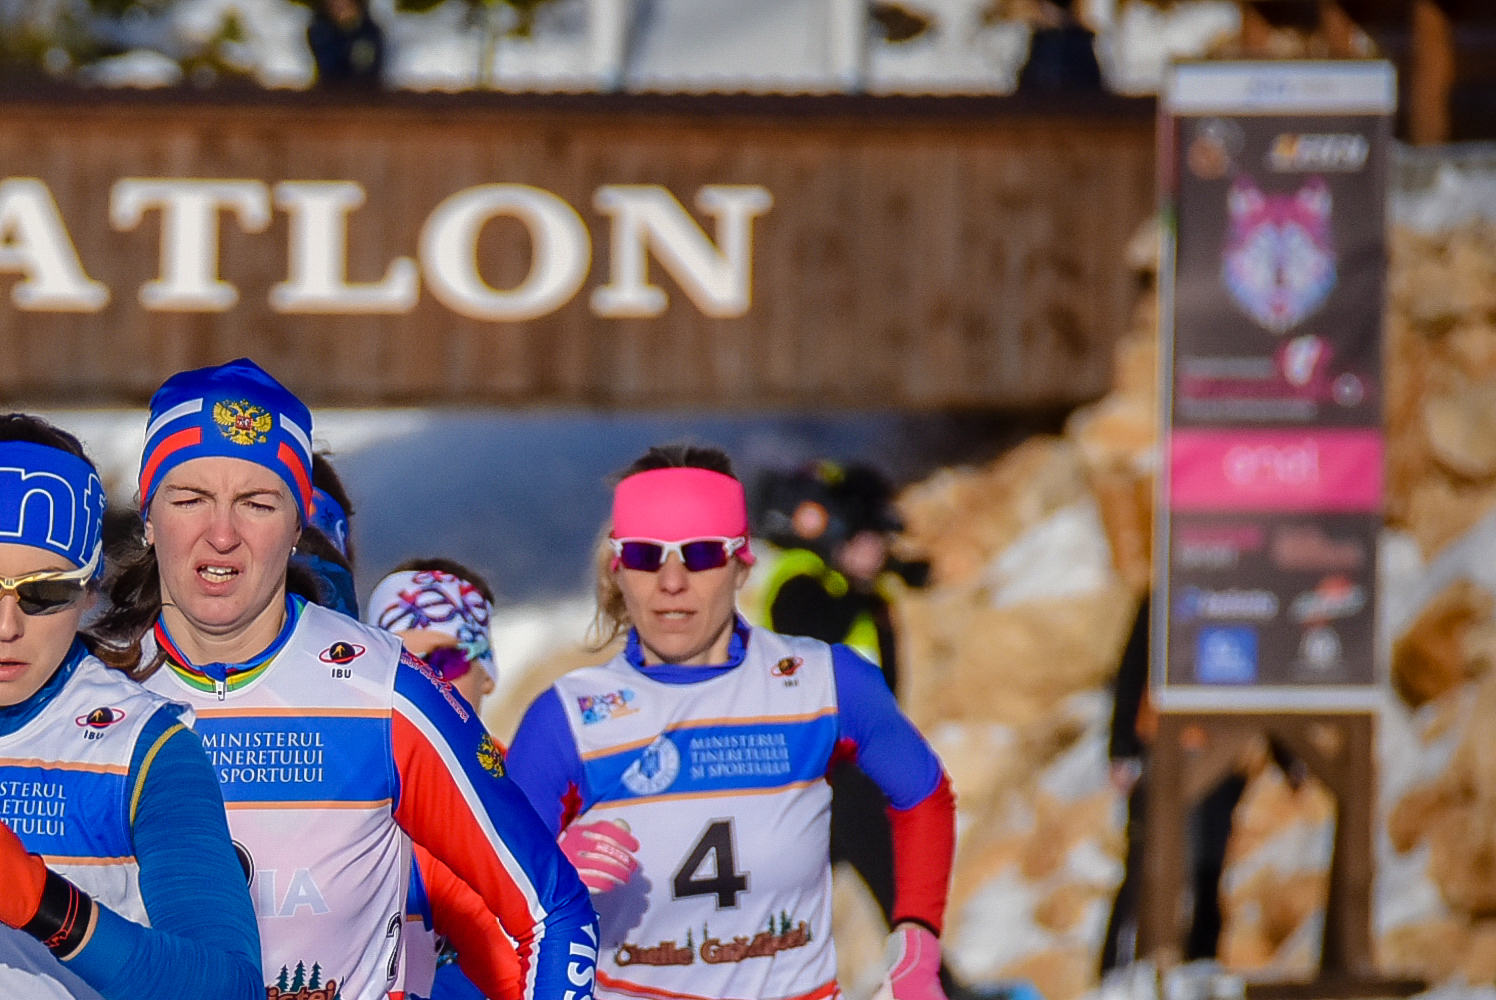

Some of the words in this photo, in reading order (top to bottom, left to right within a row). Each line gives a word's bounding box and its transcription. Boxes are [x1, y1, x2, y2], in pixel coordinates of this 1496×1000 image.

[331, 669, 352, 679] IBU
[84, 730, 104, 740] IBU
[201, 732, 324, 748] MINISTERUL
[220, 767, 324, 783] SPORTULUI
[671, 816, 751, 912] 4
